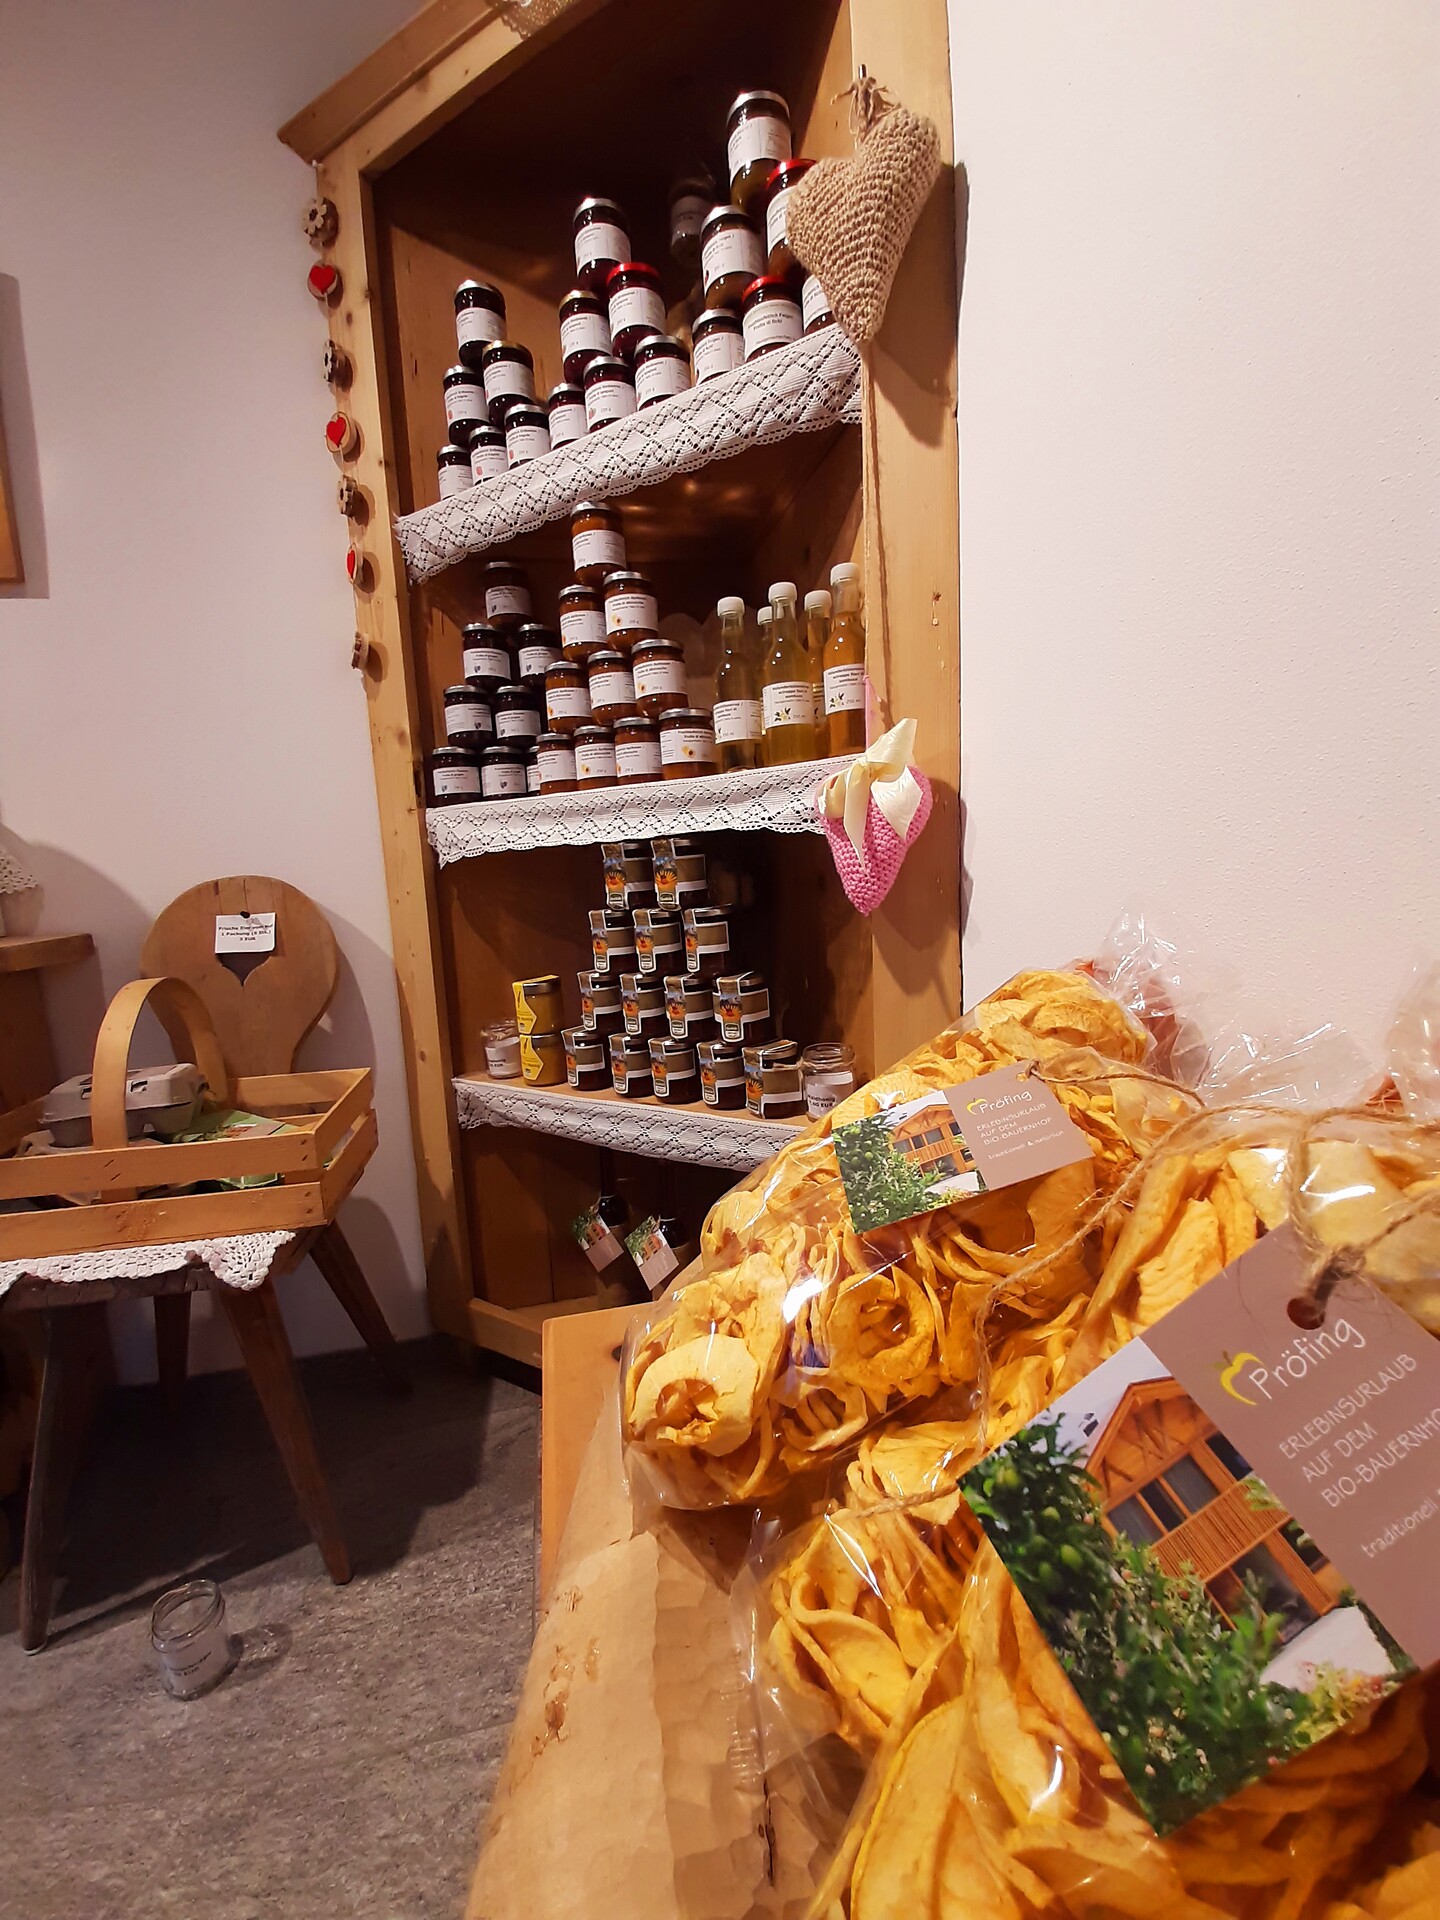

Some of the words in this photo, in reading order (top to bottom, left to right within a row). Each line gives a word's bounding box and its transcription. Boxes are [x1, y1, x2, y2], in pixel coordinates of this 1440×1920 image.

[979, 1091, 1033, 1114] Pröfing
[980, 1127, 996, 1138] AUF
[998, 1121, 1018, 1132] DEM
[983, 1117, 1052, 1146] BIO-BAUERNHOF
[1249, 1318, 1366, 1400] Pröfing
[1279, 1353, 1417, 1460] ERLEBINSURLAUB
[1302, 1449, 1335, 1483] AUF
[1334, 1421, 1378, 1458] DEM
[1361, 1496, 1438, 1558] traditionell
